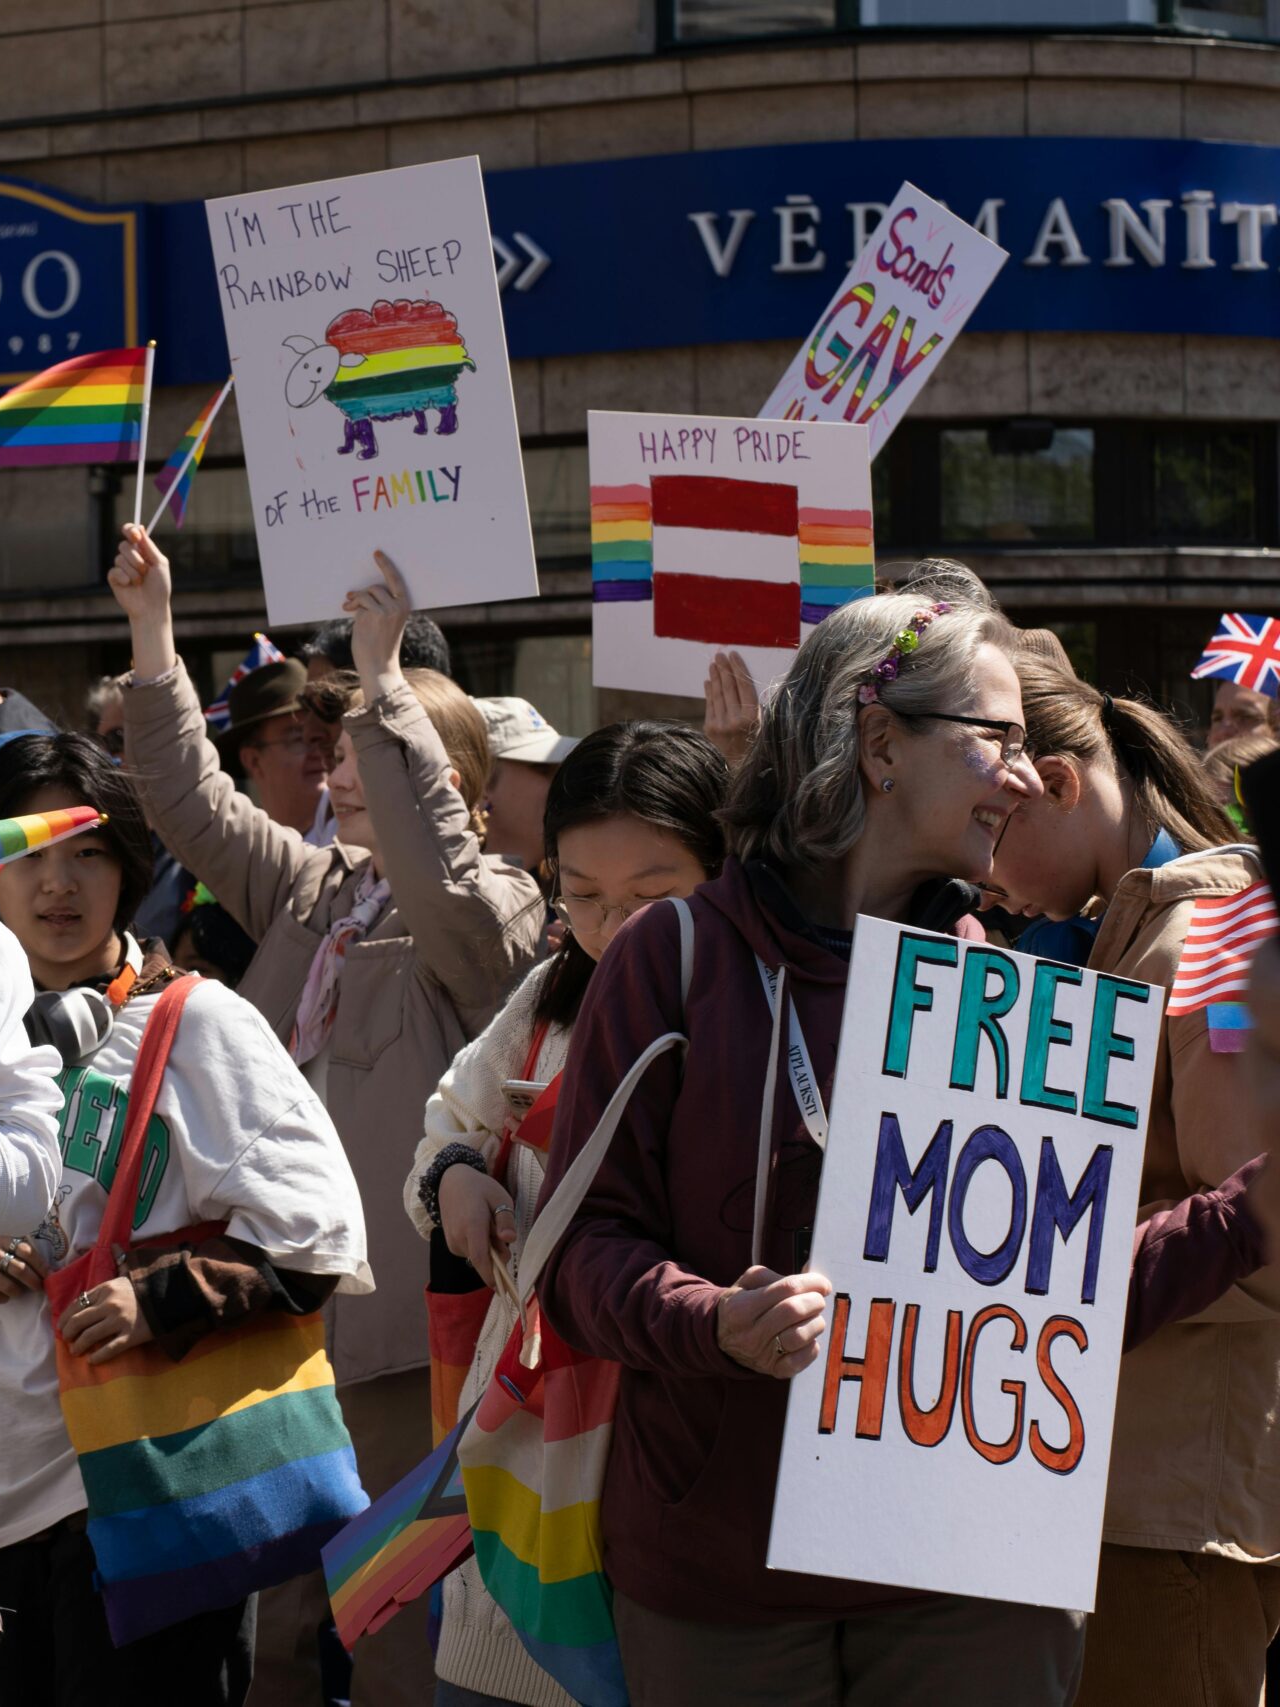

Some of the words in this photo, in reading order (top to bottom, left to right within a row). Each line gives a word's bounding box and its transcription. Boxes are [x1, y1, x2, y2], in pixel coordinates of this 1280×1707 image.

[219, 264, 352, 310] RAINBOW
[376, 239, 462, 284] SHEEP
[224, 207, 267, 253] I'M
[277, 196, 352, 239] THE
[804, 282, 944, 424] GAY
[352, 465, 462, 513] FAMILY
[638, 427, 717, 464] HAPPY
[733, 426, 812, 464] PRIDE
[882, 930, 1151, 1130] FREE
[863, 1110, 1114, 1305] MOM
[818, 1292, 1090, 1476] HUGS
